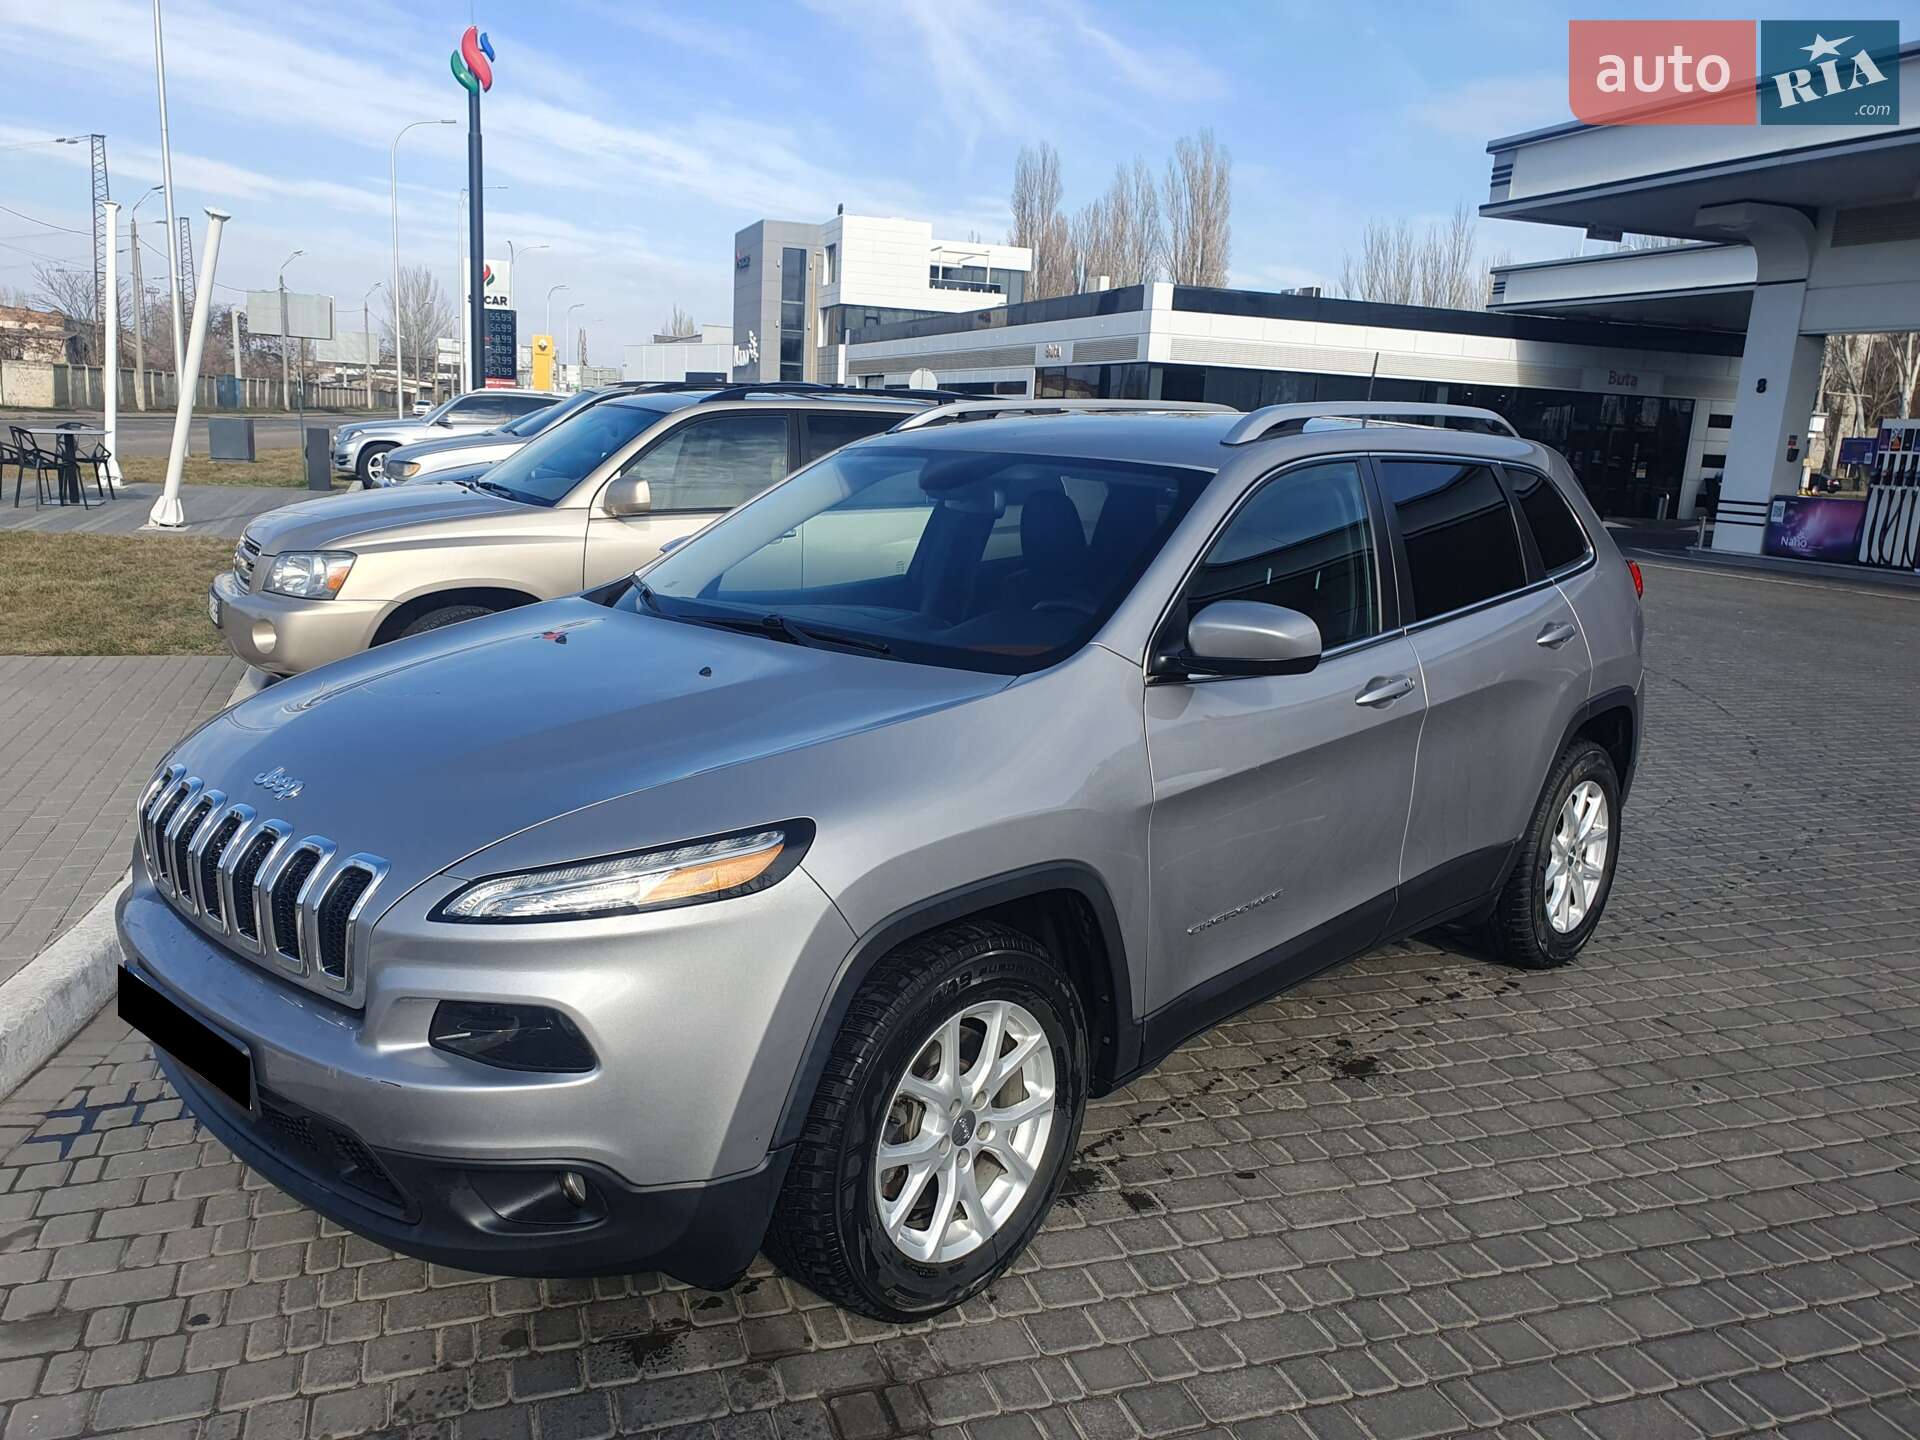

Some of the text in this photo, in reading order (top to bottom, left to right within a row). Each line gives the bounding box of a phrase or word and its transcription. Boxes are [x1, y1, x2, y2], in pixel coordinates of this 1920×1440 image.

[468, 295, 508, 306] SCAR
[1608, 369, 1639, 386] Buta
[1756, 378, 1767, 393] 8
[1780, 535, 1808, 548] Nano
